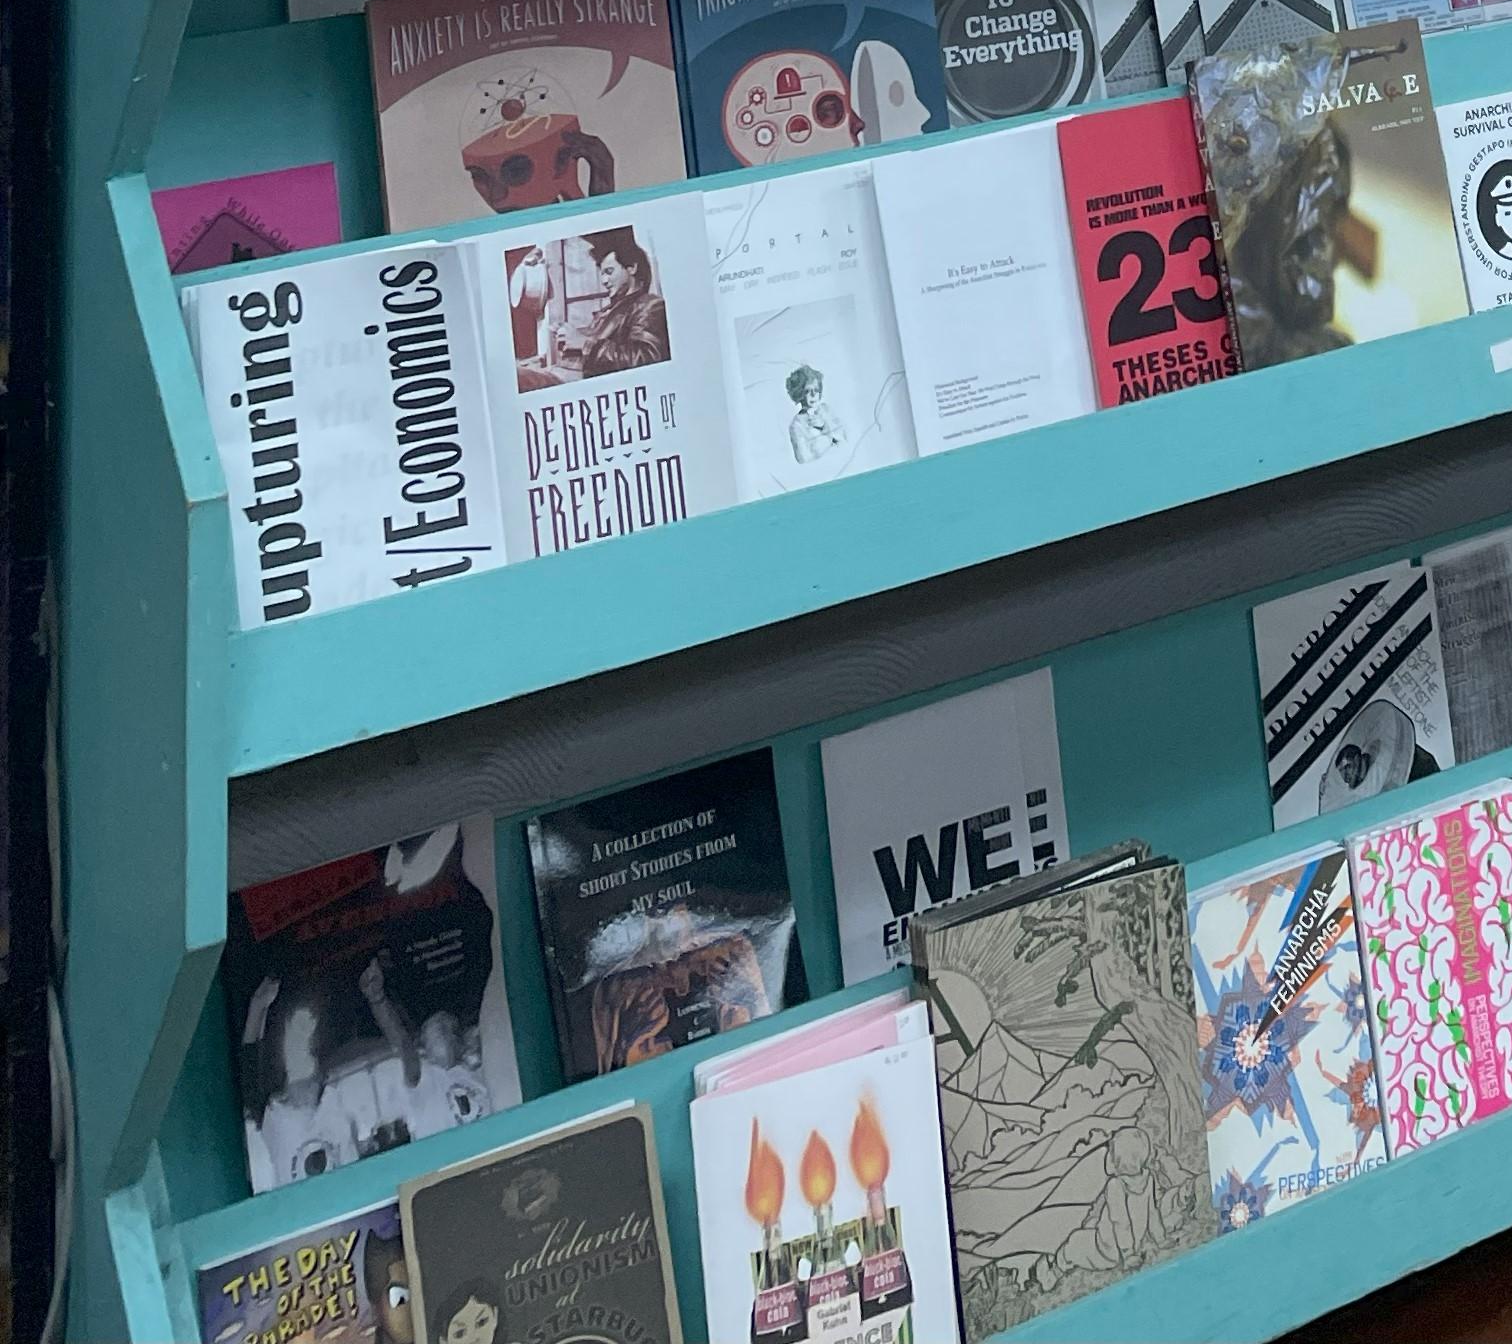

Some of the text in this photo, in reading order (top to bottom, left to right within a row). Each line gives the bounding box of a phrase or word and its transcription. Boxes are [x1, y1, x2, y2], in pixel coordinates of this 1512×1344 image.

[389, 17, 466, 76] ANXIETY
[476, 8, 491, 41] IS
[943, 30, 1082, 69] Everything
[965, 8, 1057, 38] Change
[1453, 117, 1504, 139] SURVIVAL
[1086, 185, 1163, 212] REVOLUTION
[1096, 215, 1226, 347] 23
[1114, 341, 1208, 382] THESES
[525, 386, 677, 482] DEGREES OF
[590, 833, 603, 861] A
[1275, 882, 1337, 979] ANARCHA-
[1445, 820, 1479, 983] IMAGINATIONS
[1271, 919, 1341, 1015] FEMINISMS
[506, 1211, 652, 1280] solidarity
[506, 1235, 657, 1310] UNIONISM
